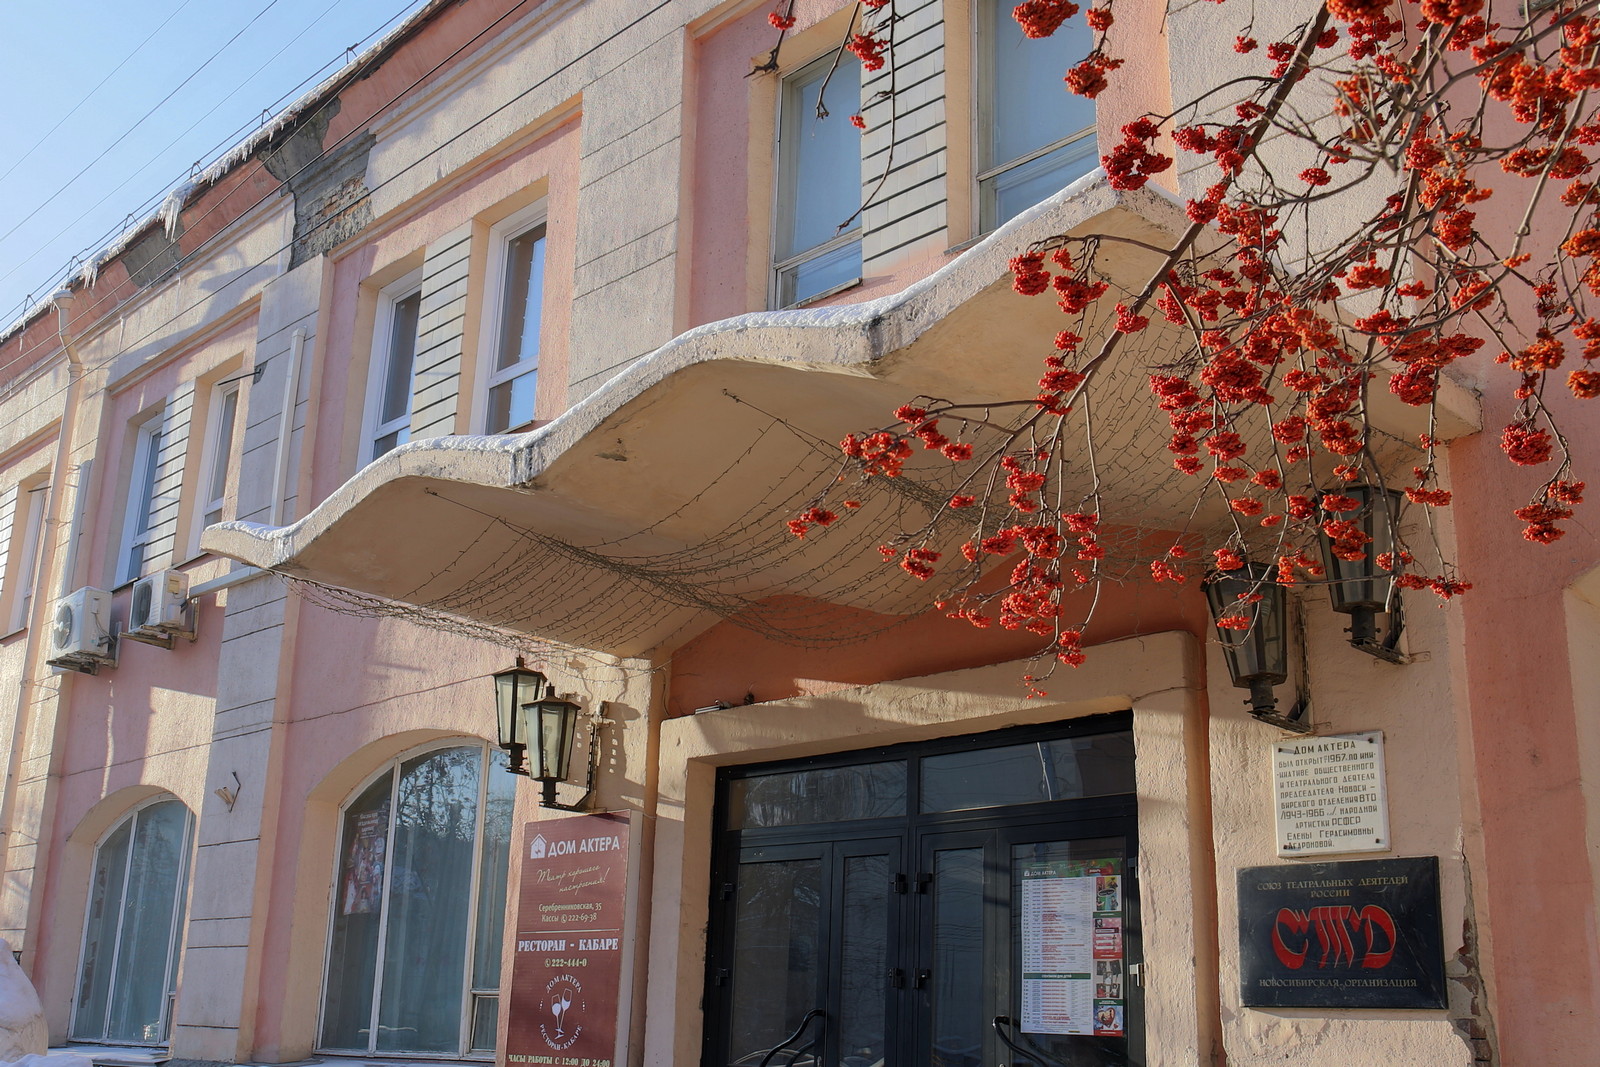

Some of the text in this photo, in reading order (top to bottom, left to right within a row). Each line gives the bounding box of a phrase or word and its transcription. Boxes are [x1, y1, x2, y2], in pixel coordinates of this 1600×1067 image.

[1294, 740, 1356, 755] ДОМ АКТЕРА
[1279, 760, 1294, 768] БЫЛ
[1296, 757, 1323, 766] ОТКРЫТ
[1348, 753, 1358, 761] ПО
[1314, 762, 1374, 774] ОБЩЕСТВЕННОГО
[1286, 776, 1338, 788] ТЕАТРАЛЬНОГО
[1343, 773, 1375, 783] ДЕЯТЕЛЯ
[1280, 788, 1334, 799] ПРЕДСЕДАТЕЛЯ
[1281, 793, 1376, 810] БИРСКОГО ОТДЕЛЕНИЯ ВТО
[1340, 804, 1378, 814] НАРОДНОЙ
[1296, 816, 1360, 830] АРТИСТКИ РСФСР
[548, 836, 620, 858] ДОМ АКТЕРА
[1258, 876, 1408, 891] СОЮЗ ТЕАТРАЛЬНЫХ ДЕЯТЕЛЕЙ
[1310, 890, 1350, 898] РОССИИ
[595, 902, 602, 910] 35
[542, 912, 597, 922] Кассы 222-69-38
[518, 940, 566, 952] РЕСТОРАН
[578, 938, 618, 950] КАБАРЕ
[552, 958, 588, 968] 222-444-0
[546, 974, 582, 994] ДОМ АКТЕРА
[1259, 979, 1418, 988] НОВОСИБИРСКАЯ ОРГАНИЗАЦИЯ
[508, 1054, 526, 1062] ЧАСЫ
[528, 1056, 552, 1064] РАБОТЫ
[562, 1058, 578, 1066] 12:00
[580, 1058, 590, 1067] ДО
[592, 1059, 610, 1067] 24:00
